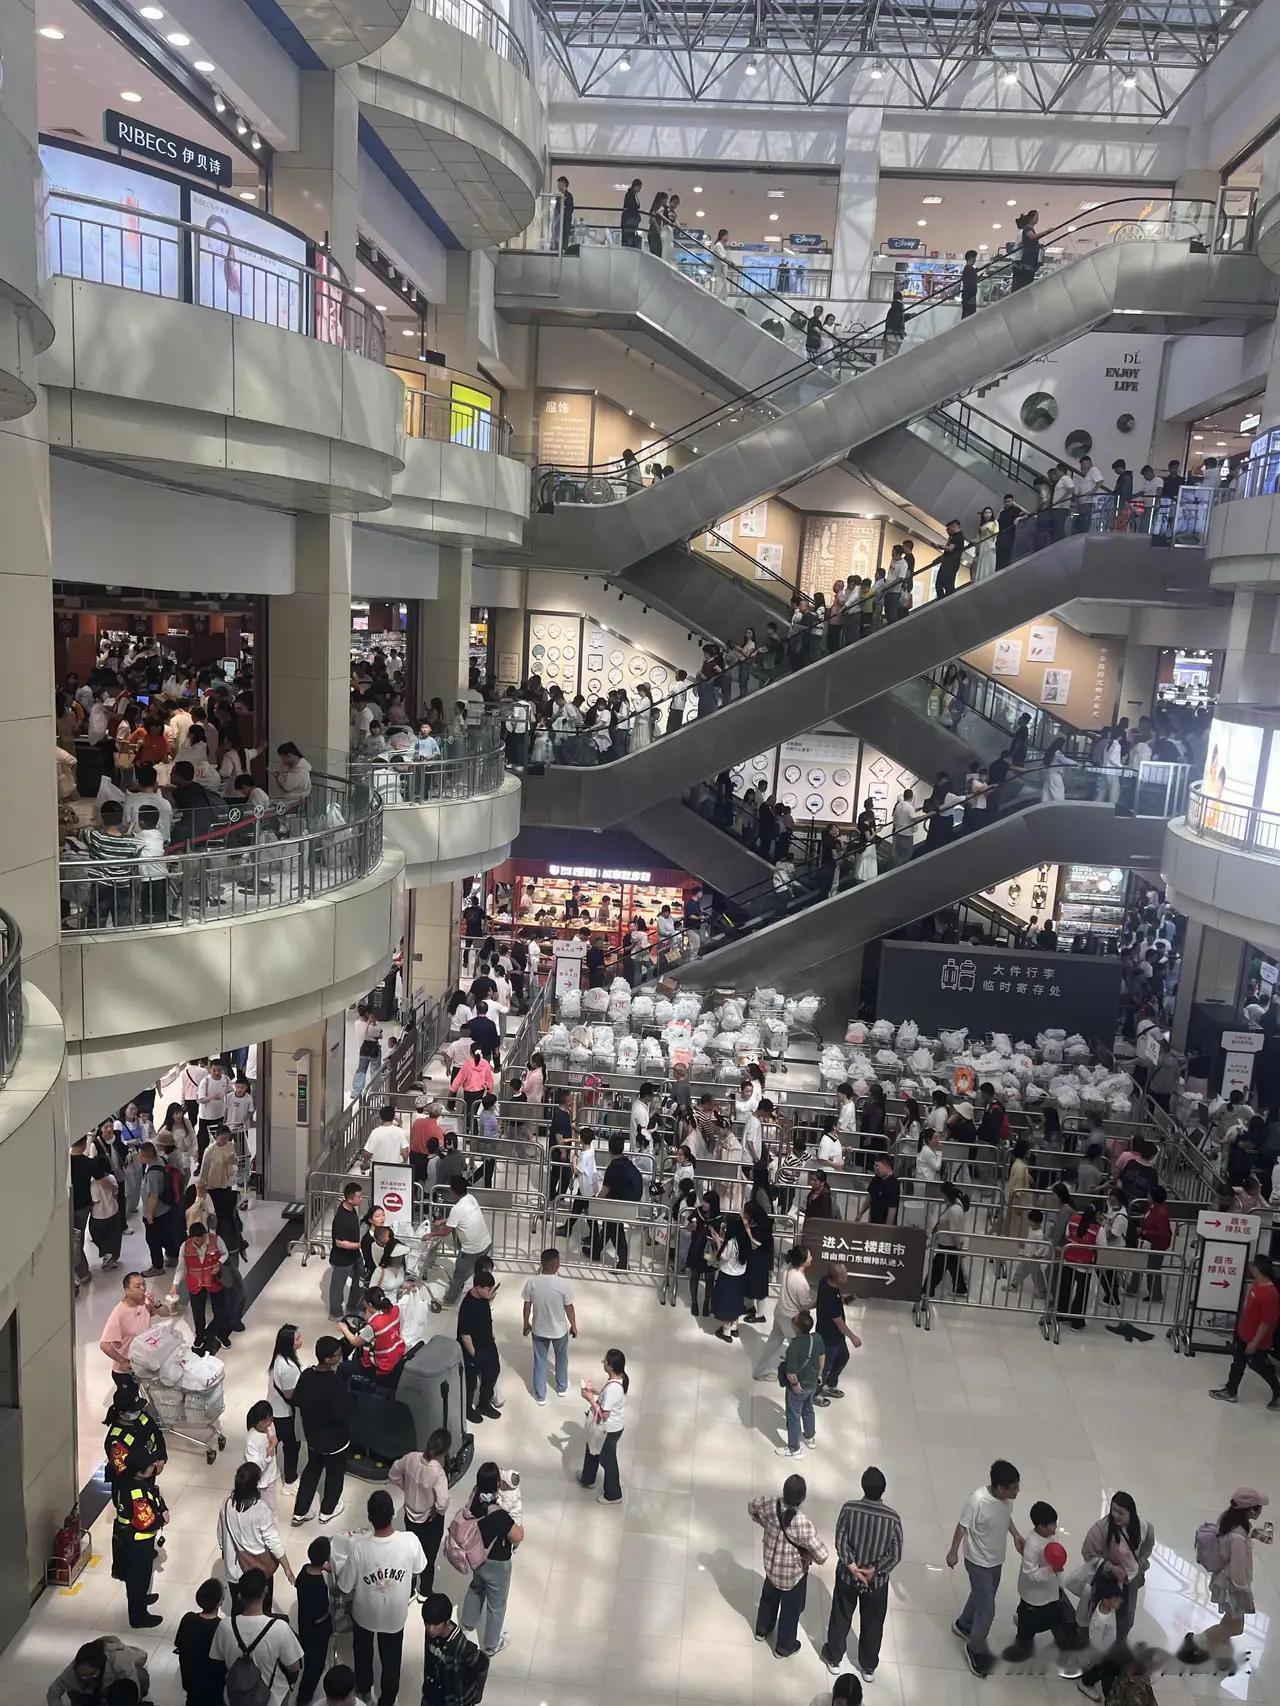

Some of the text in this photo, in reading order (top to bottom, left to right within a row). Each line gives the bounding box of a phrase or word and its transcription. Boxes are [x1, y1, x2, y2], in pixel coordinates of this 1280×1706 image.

[118, 121, 221, 175] RIBECS 伊贝诗
[792, 234, 817, 245] Disney
[1104, 367, 1141, 379] ENJOY
[1114, 380, 1139, 392] LIFE
[992, 964, 1056, 979] 大件行李
[982, 980, 1061, 997] 临时寄存处
[1230, 1217, 1249, 1226] 超市
[1224, 1225, 1251, 1235] 排队区
[822, 1235, 906, 1256] 进入二楼超市
[821, 1251, 905, 1268] 请由南门东侧排队进入
[1214, 1255, 1234, 1265] 超市
[1207, 1265, 1238, 1276] 排队区
